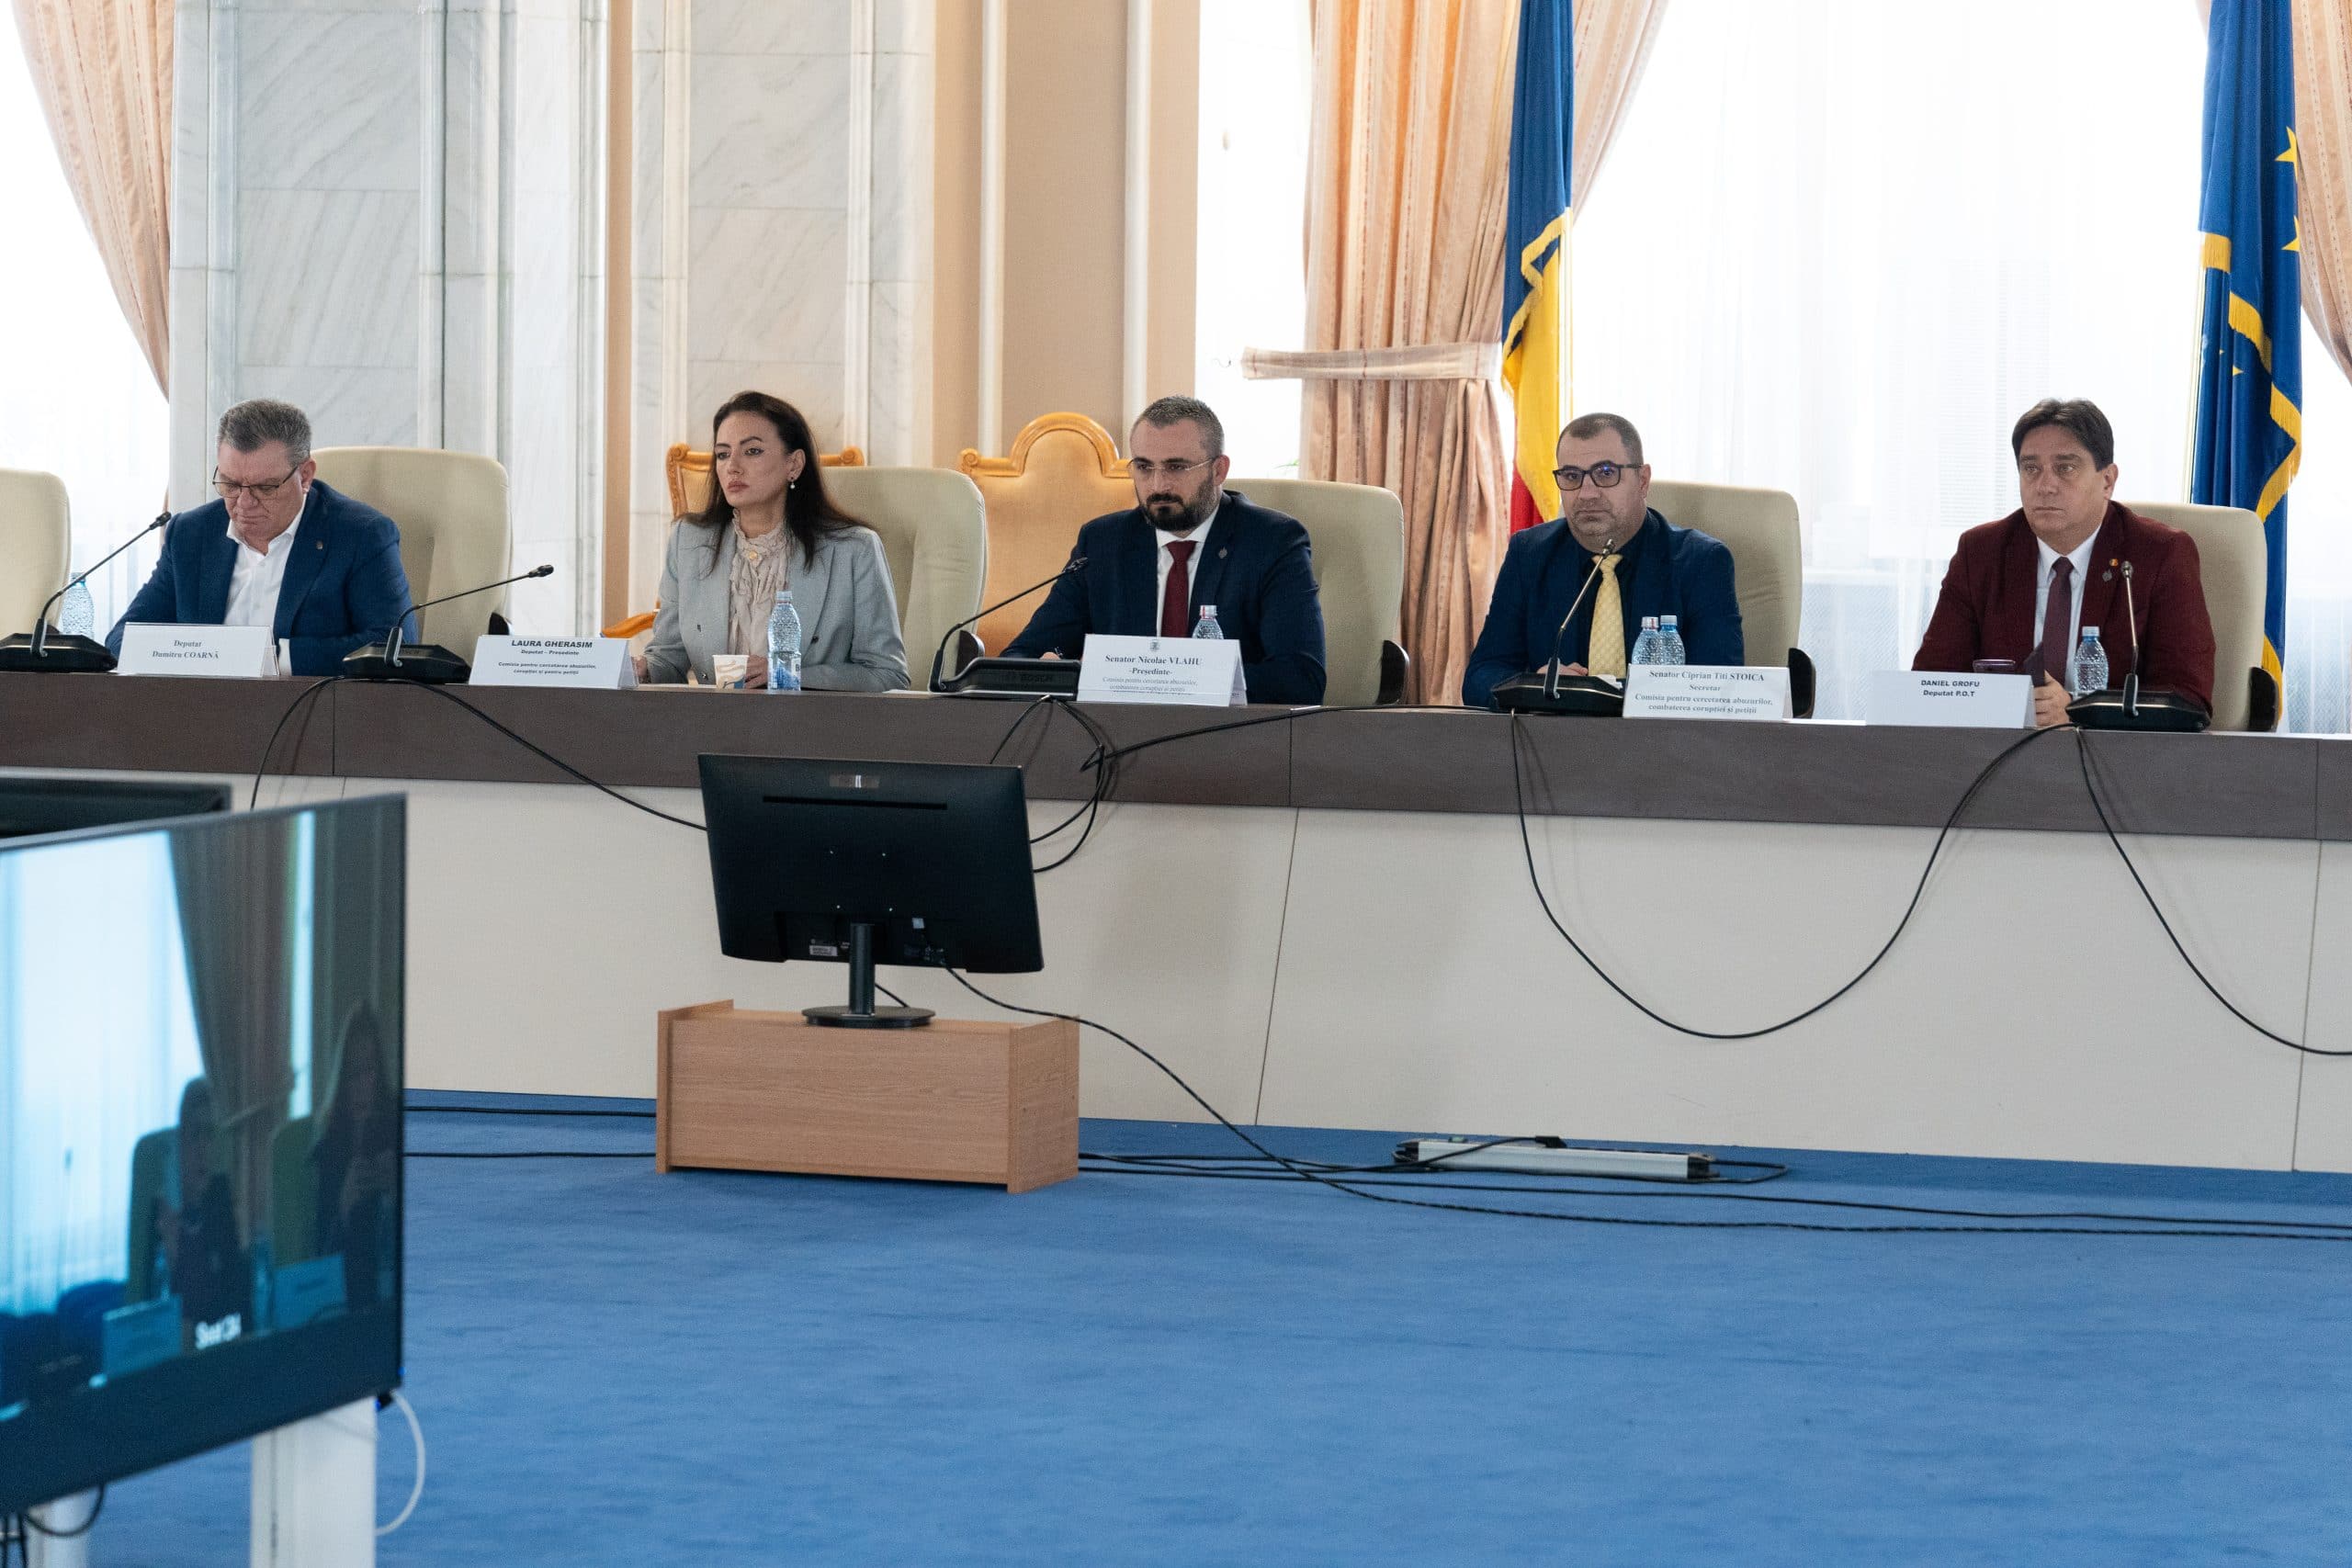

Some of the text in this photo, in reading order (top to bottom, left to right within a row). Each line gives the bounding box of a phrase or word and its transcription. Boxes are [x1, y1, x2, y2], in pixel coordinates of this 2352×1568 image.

[174, 639, 202, 649] Deputat
[511, 639, 593, 649] LAURA GHERASIM
[152, 650, 220, 660] Dumitru COARNĂ
[1104, 655, 1203, 665] Senator Nicolae VLAHU
[1648, 671, 1765, 682] Senator Ciprian Titi STOICA
[1689, 683, 1721, 692] Secretar
[1666, 694, 1691, 703] pentru
